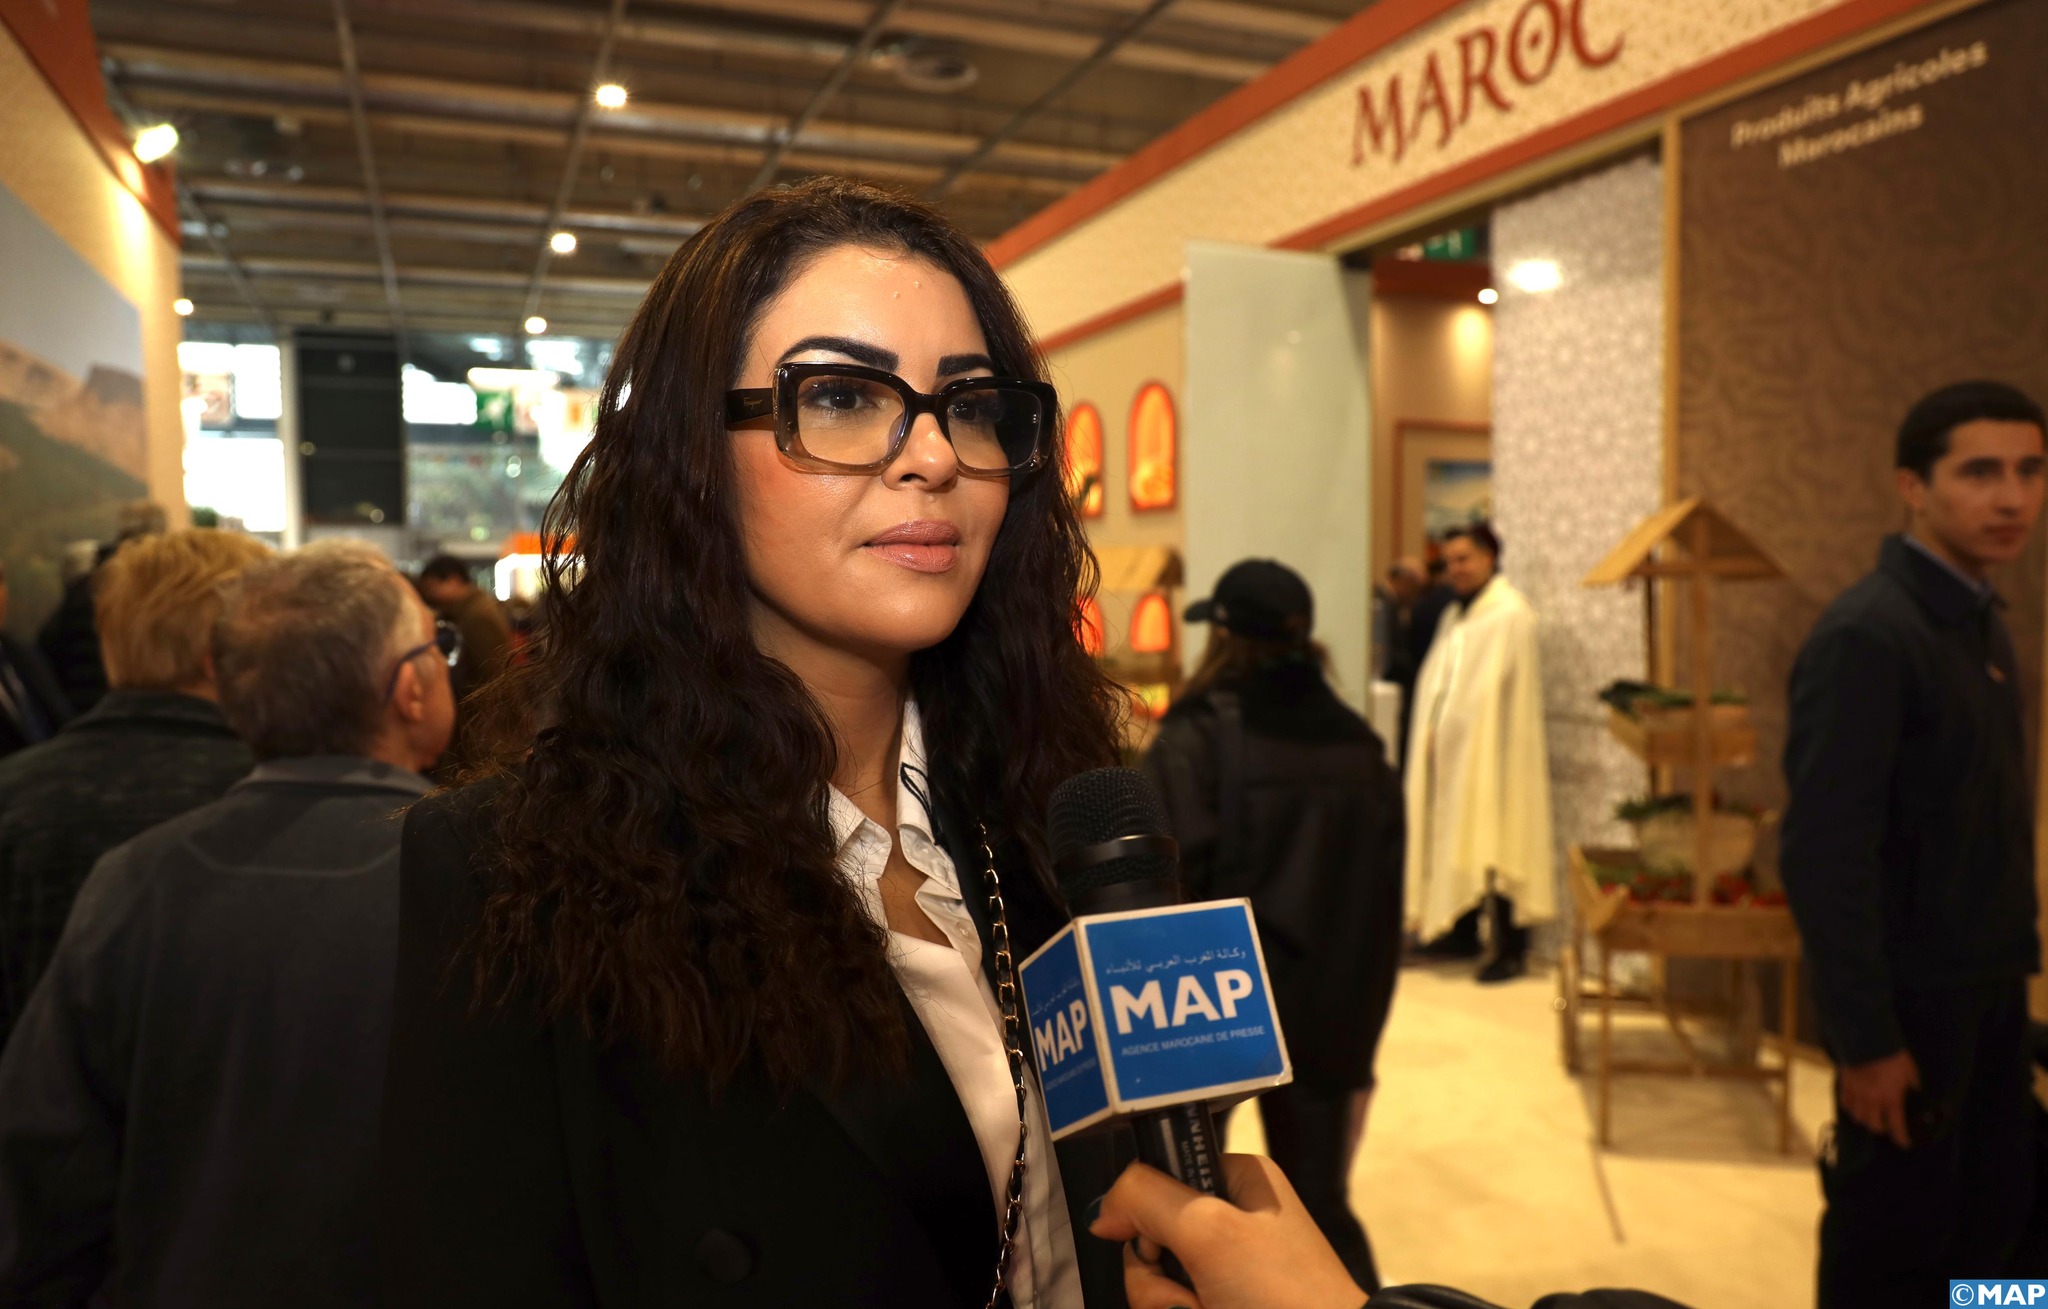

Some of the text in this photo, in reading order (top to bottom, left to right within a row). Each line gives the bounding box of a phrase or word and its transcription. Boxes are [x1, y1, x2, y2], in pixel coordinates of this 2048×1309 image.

[1352, 0, 1626, 166] MAROC
[1731, 40, 1987, 148] Produits Agricoles
[1779, 104, 1923, 168] Marocains
[1034, 999, 1087, 1072] MAP
[1109, 969, 1253, 1035] MAP
[1122, 1025, 1265, 1056] AGENCE MAROCAINE DE PRESSE
